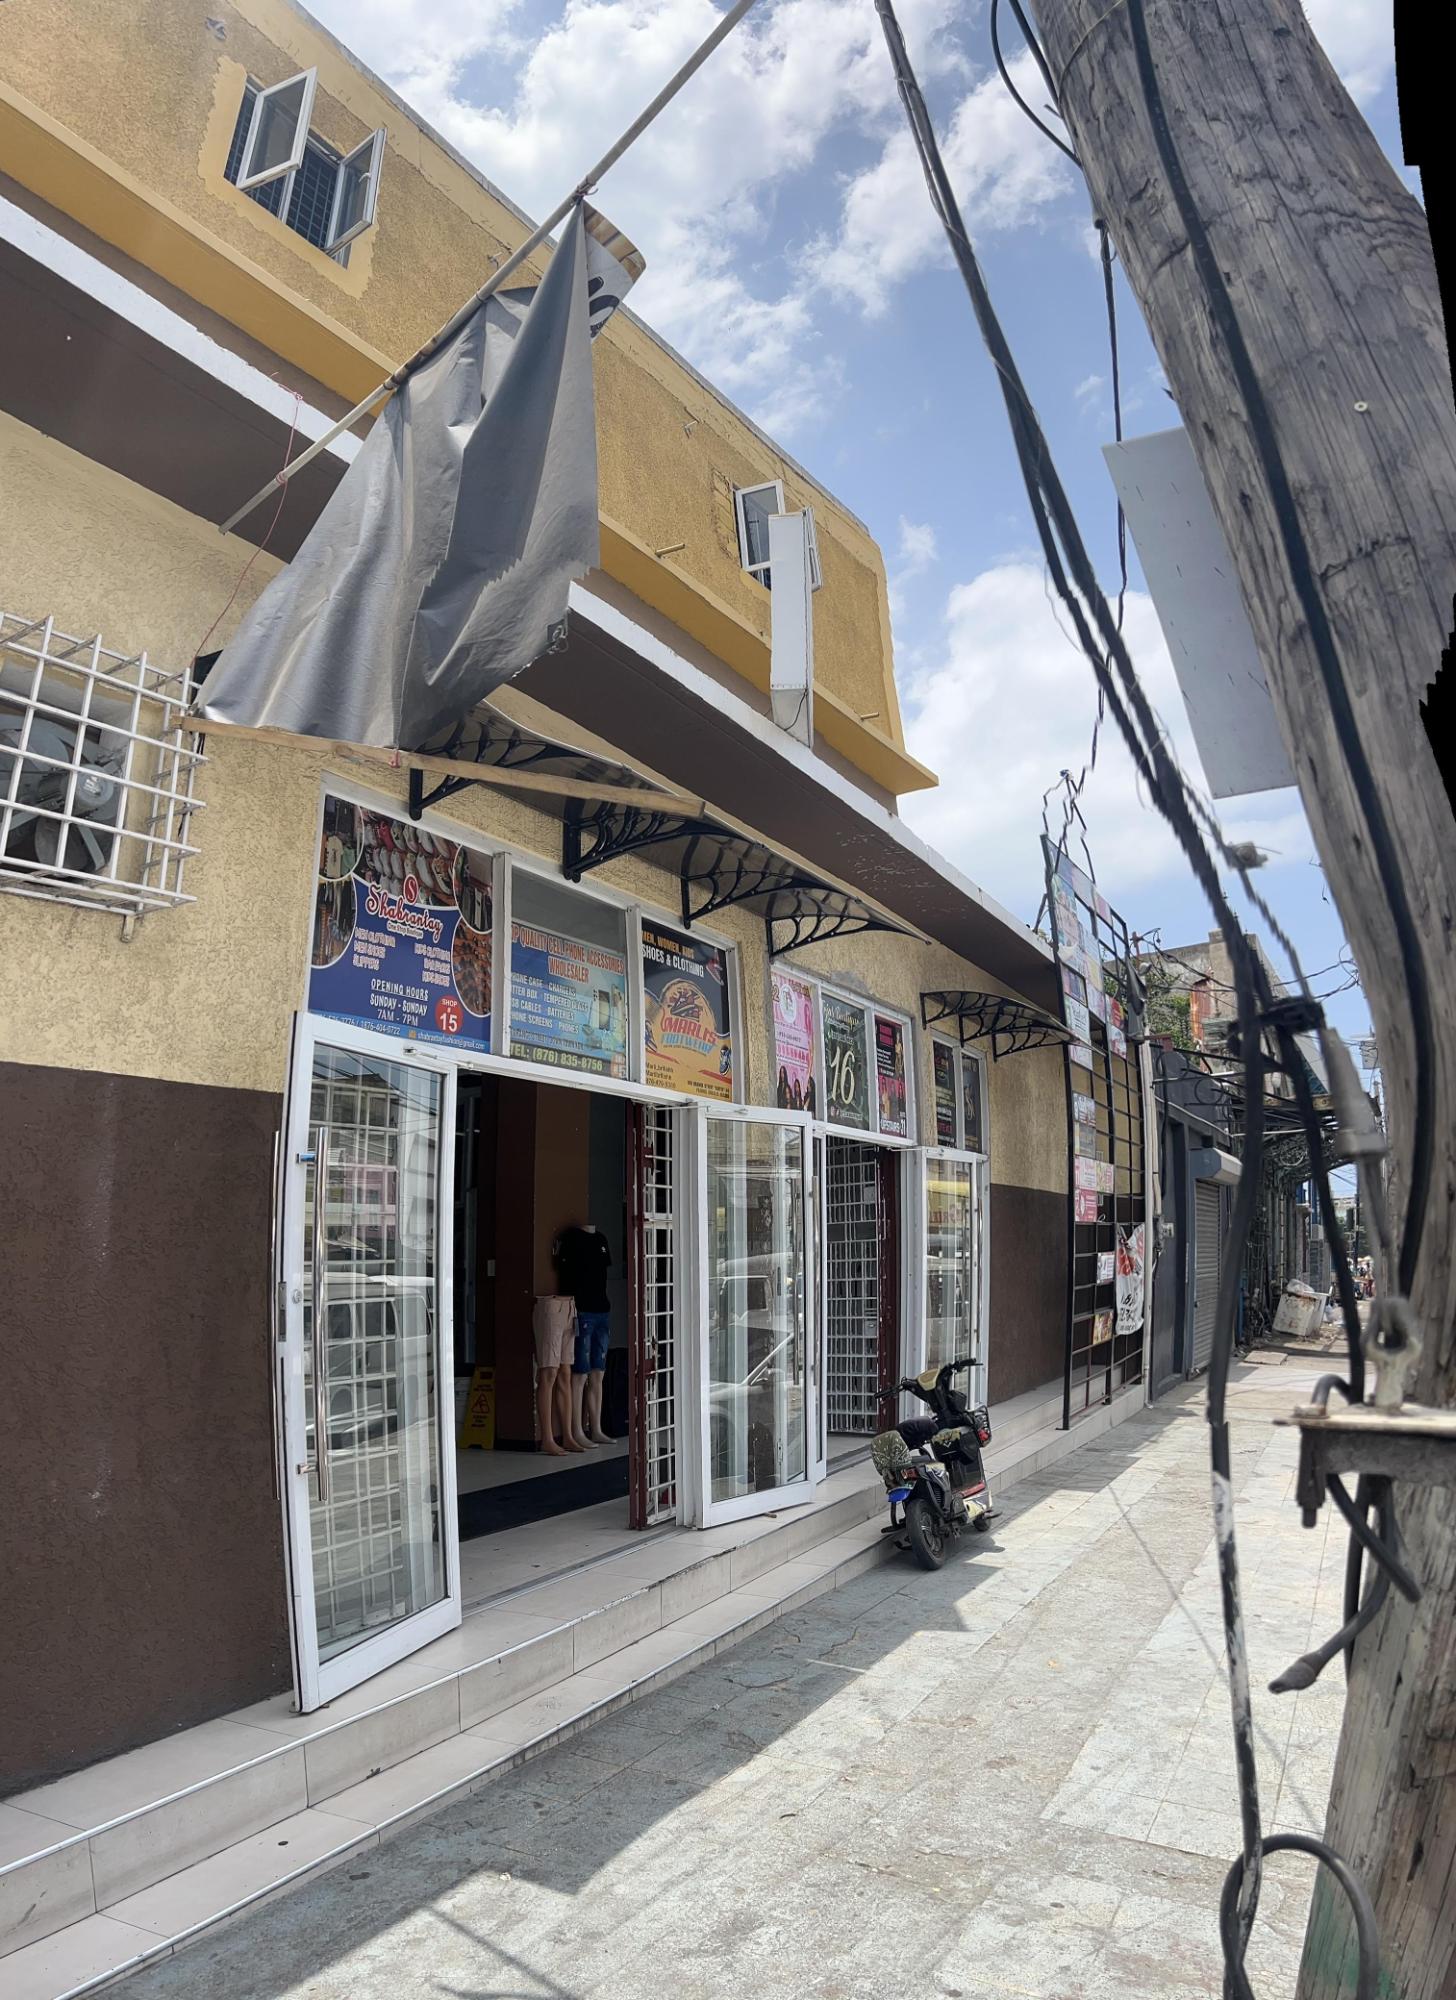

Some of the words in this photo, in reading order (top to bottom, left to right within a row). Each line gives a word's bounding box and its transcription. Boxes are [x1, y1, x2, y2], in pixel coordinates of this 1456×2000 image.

[548, 956, 589, 983] WHOLESALER
[642, 944, 664, 963] SHOES
[666, 954, 671, 966] &
[672, 955, 704, 978] CLOTHING
[371, 978, 403, 995] OPENING
[406, 987, 429, 1000] HOURS
[526, 988, 538, 999] BOX
[370, 993, 397, 1009] SUNDAY
[402, 1001, 428, 1016] SUNDAY
[441, 998, 458, 1007] SHOP
[377, 1009, 394, 1021] 7AM
[402, 1014, 418, 1026] 7PM
[440, 1015, 458, 1033] 15
[510, 1043, 529, 1057] TEL:
[533, 1047, 558, 1064] (876)
[830, 1046, 855, 1105] 16
